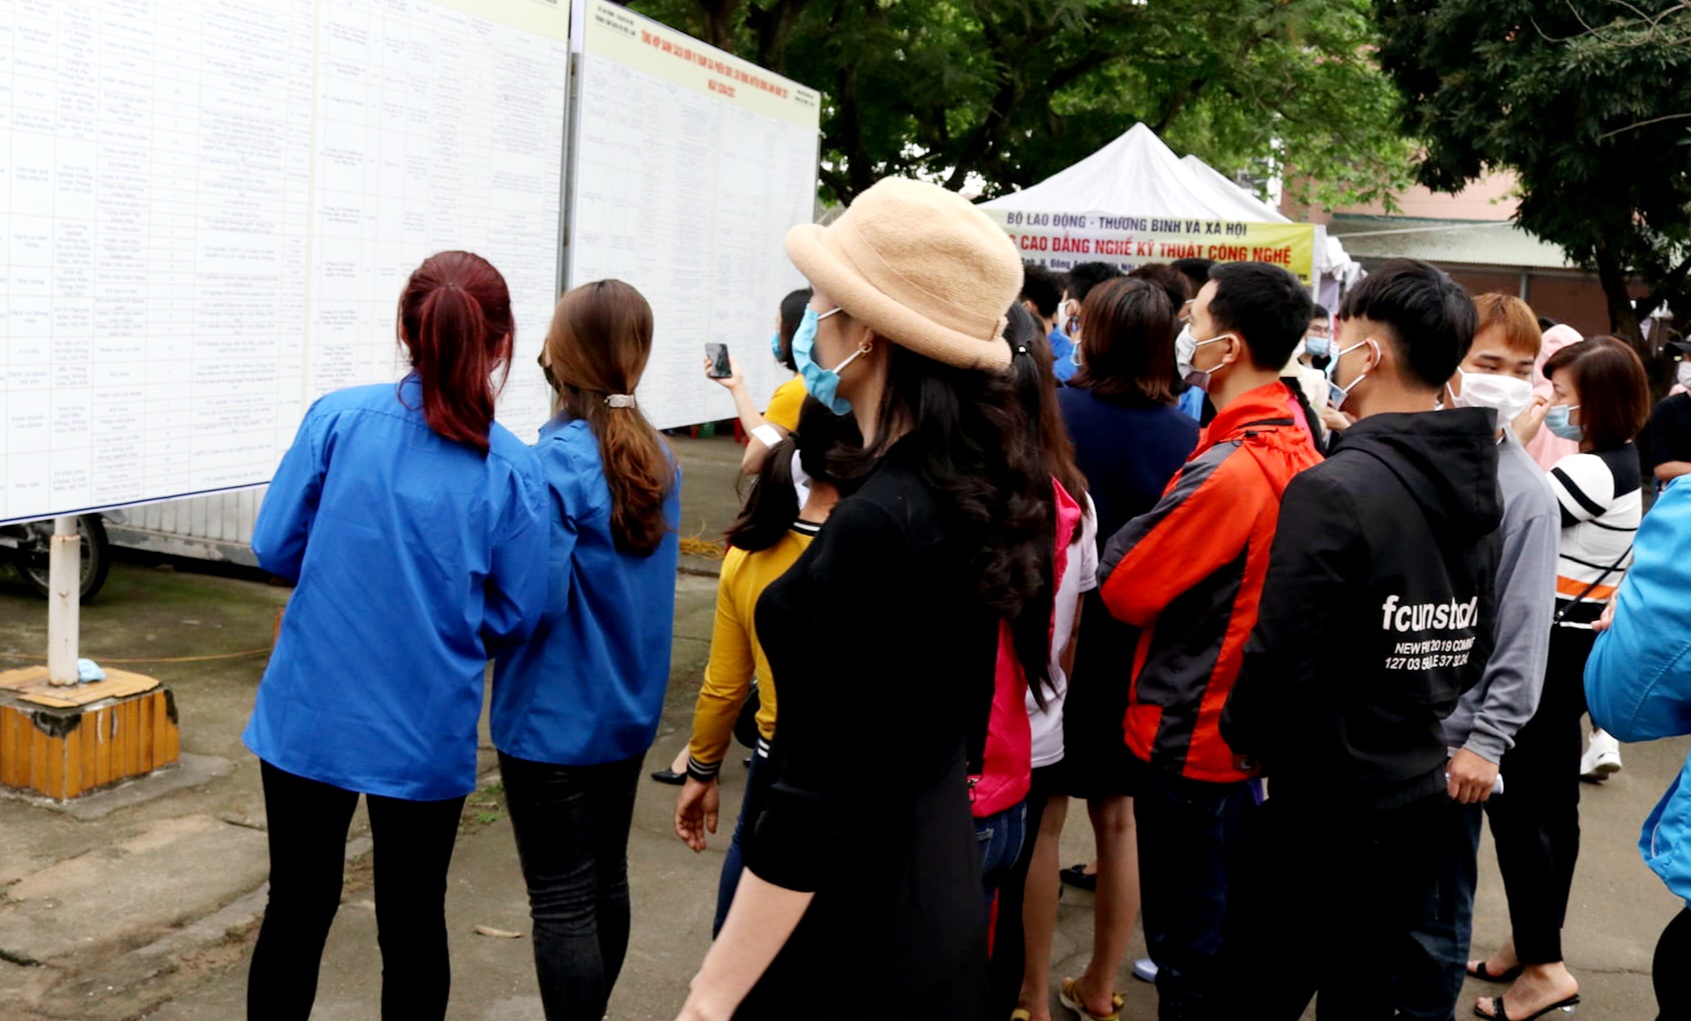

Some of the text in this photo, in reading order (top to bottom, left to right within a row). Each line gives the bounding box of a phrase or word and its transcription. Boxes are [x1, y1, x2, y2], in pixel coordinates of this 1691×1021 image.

[1007, 211, 1023, 227] BỘ
[1027, 213, 1049, 226] LAO
[1053, 213, 1086, 230] ĐỘNG
[1099, 216, 1147, 232] THƯƠNG
[1152, 218, 1181, 233] BINH
[1226, 221, 1247, 239] HỘI
[1020, 234, 1048, 251] CAO
[1208, 243, 1248, 261] CÔNG
[1252, 246, 1292, 268] NGHỆ
[1394, 643, 1421, 655] NEW
[1430, 640, 1452, 652] 2019
[1385, 657, 1406, 669] 127
[1407, 657, 1420, 670] 03
[1439, 655, 1453, 667] 37
